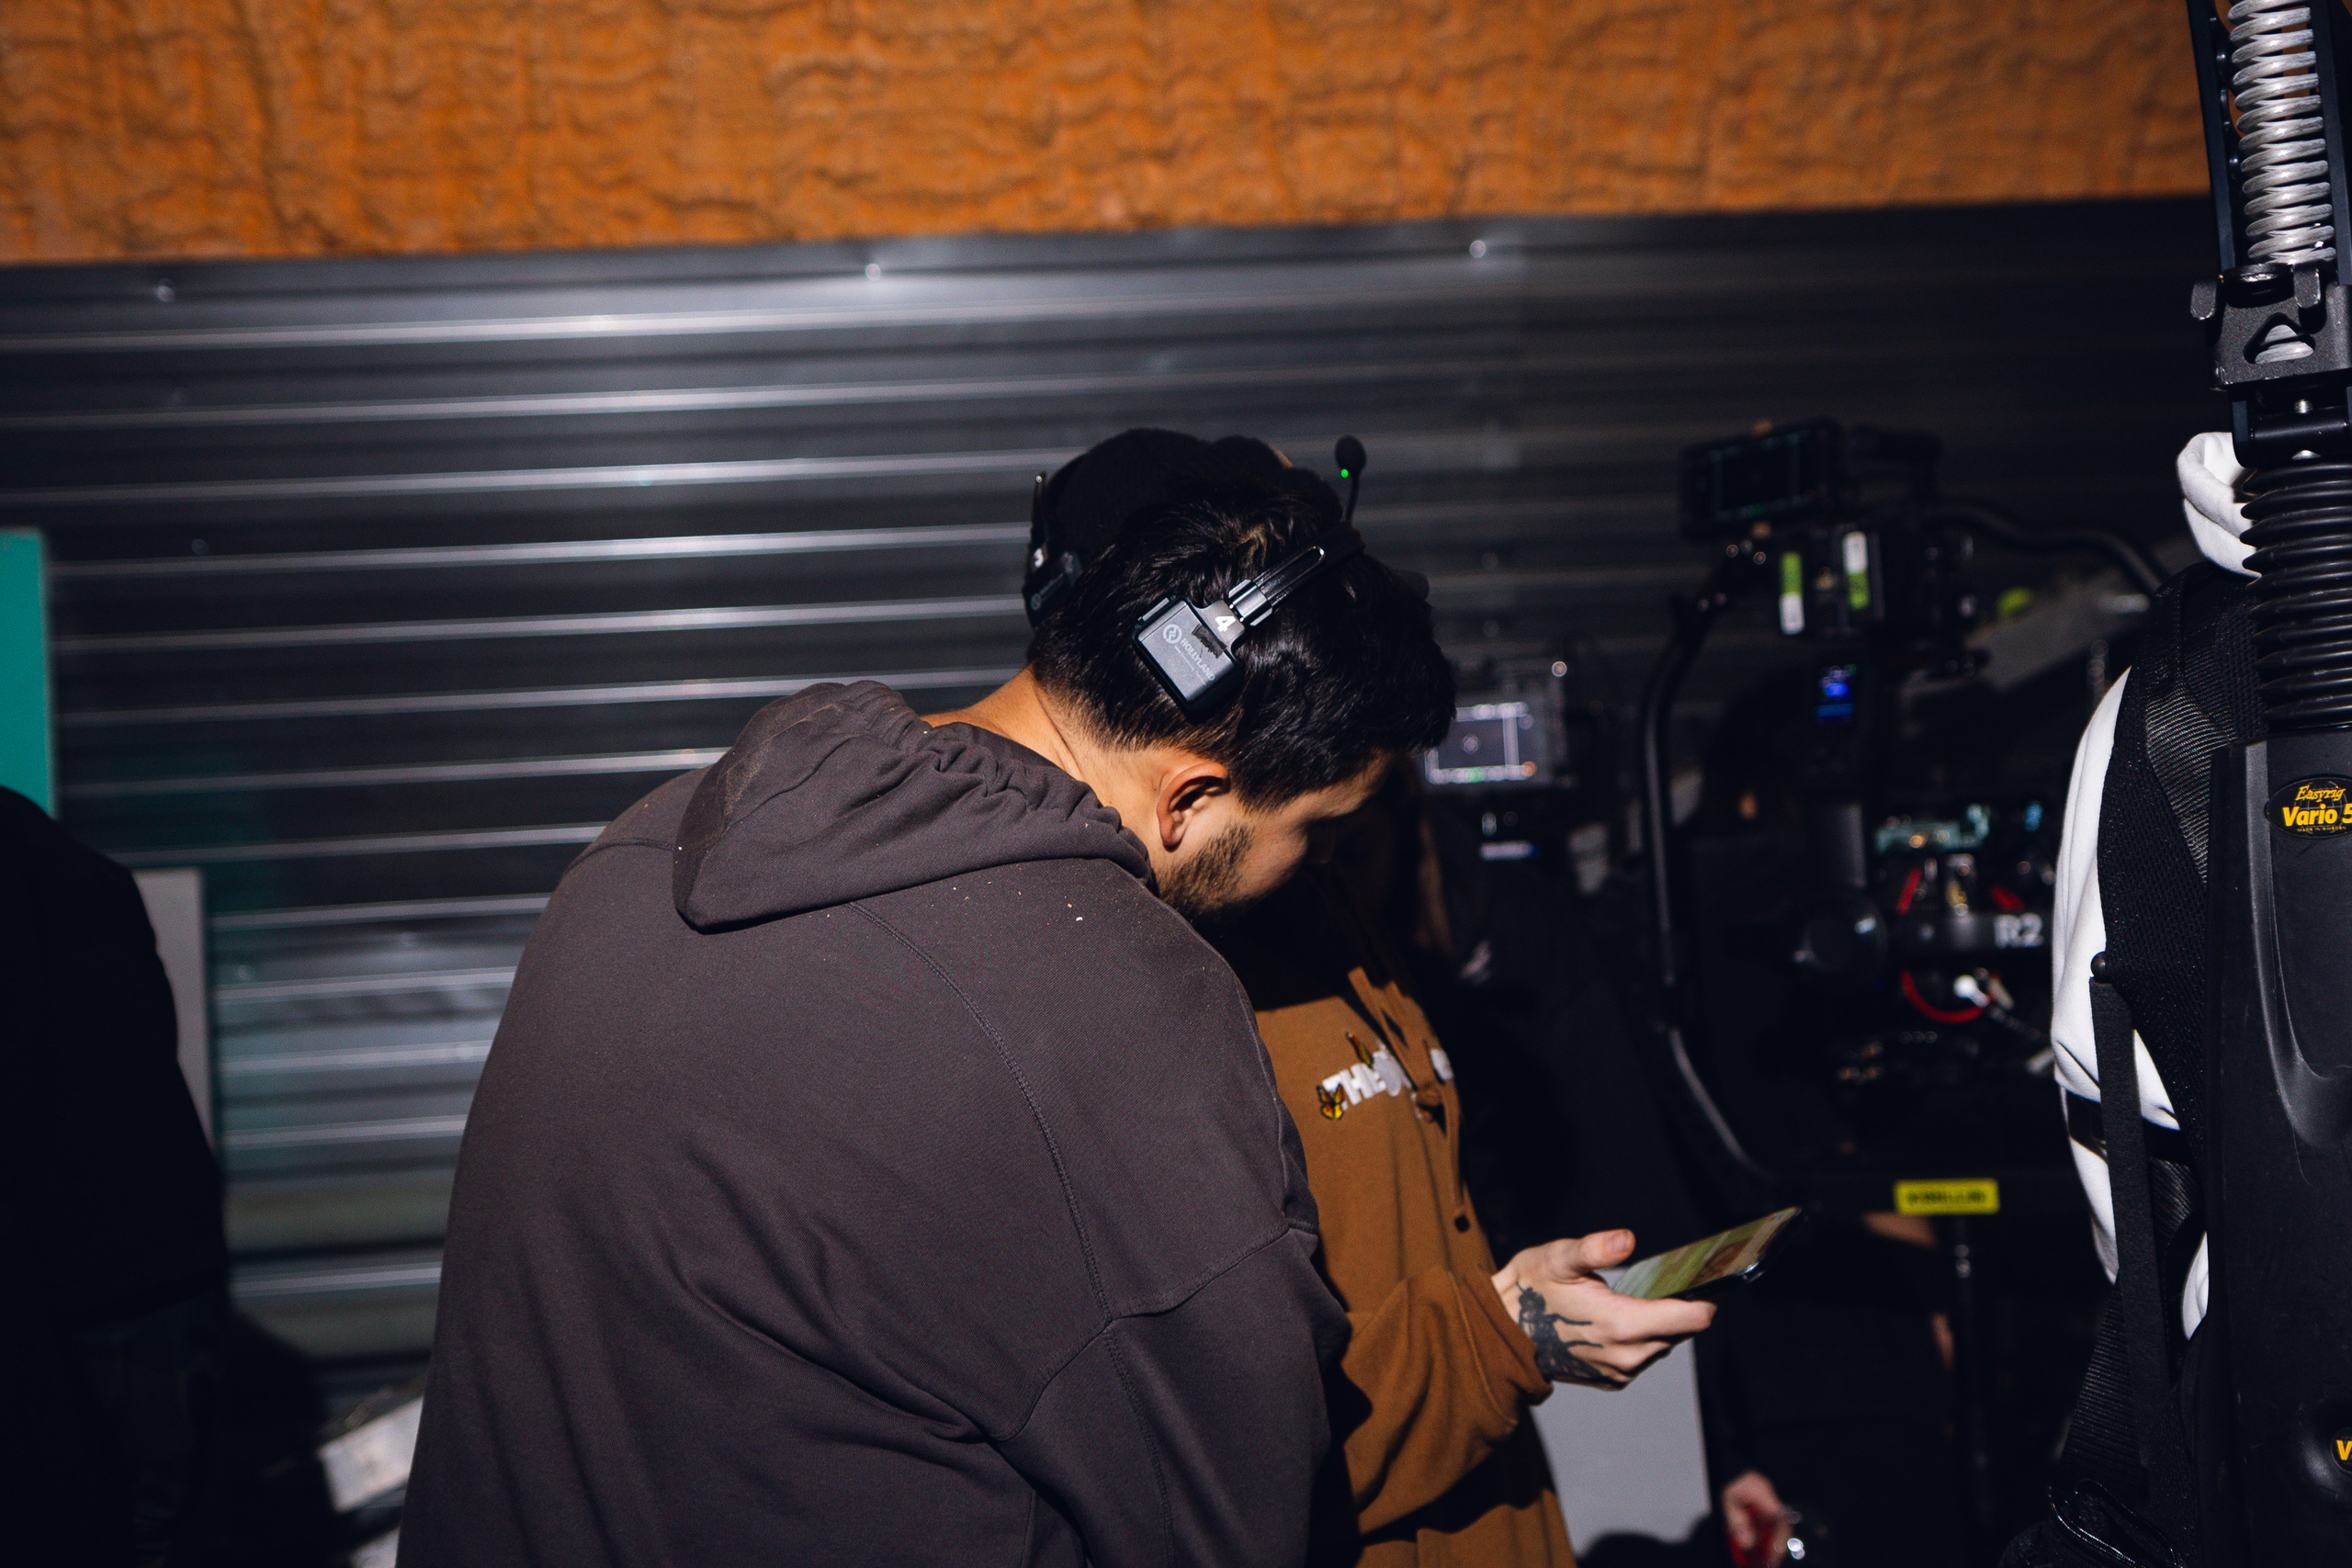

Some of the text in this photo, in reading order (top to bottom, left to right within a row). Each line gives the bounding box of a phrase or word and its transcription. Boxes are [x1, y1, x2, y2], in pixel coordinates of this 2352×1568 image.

[1215, 615, 1236, 632] 4
[1181, 637, 1216, 681] HOLLYLAND
[2295, 784, 2346, 802] Easyrig
[2281, 803, 2338, 827] Vario
[1993, 911, 2044, 949] R2
